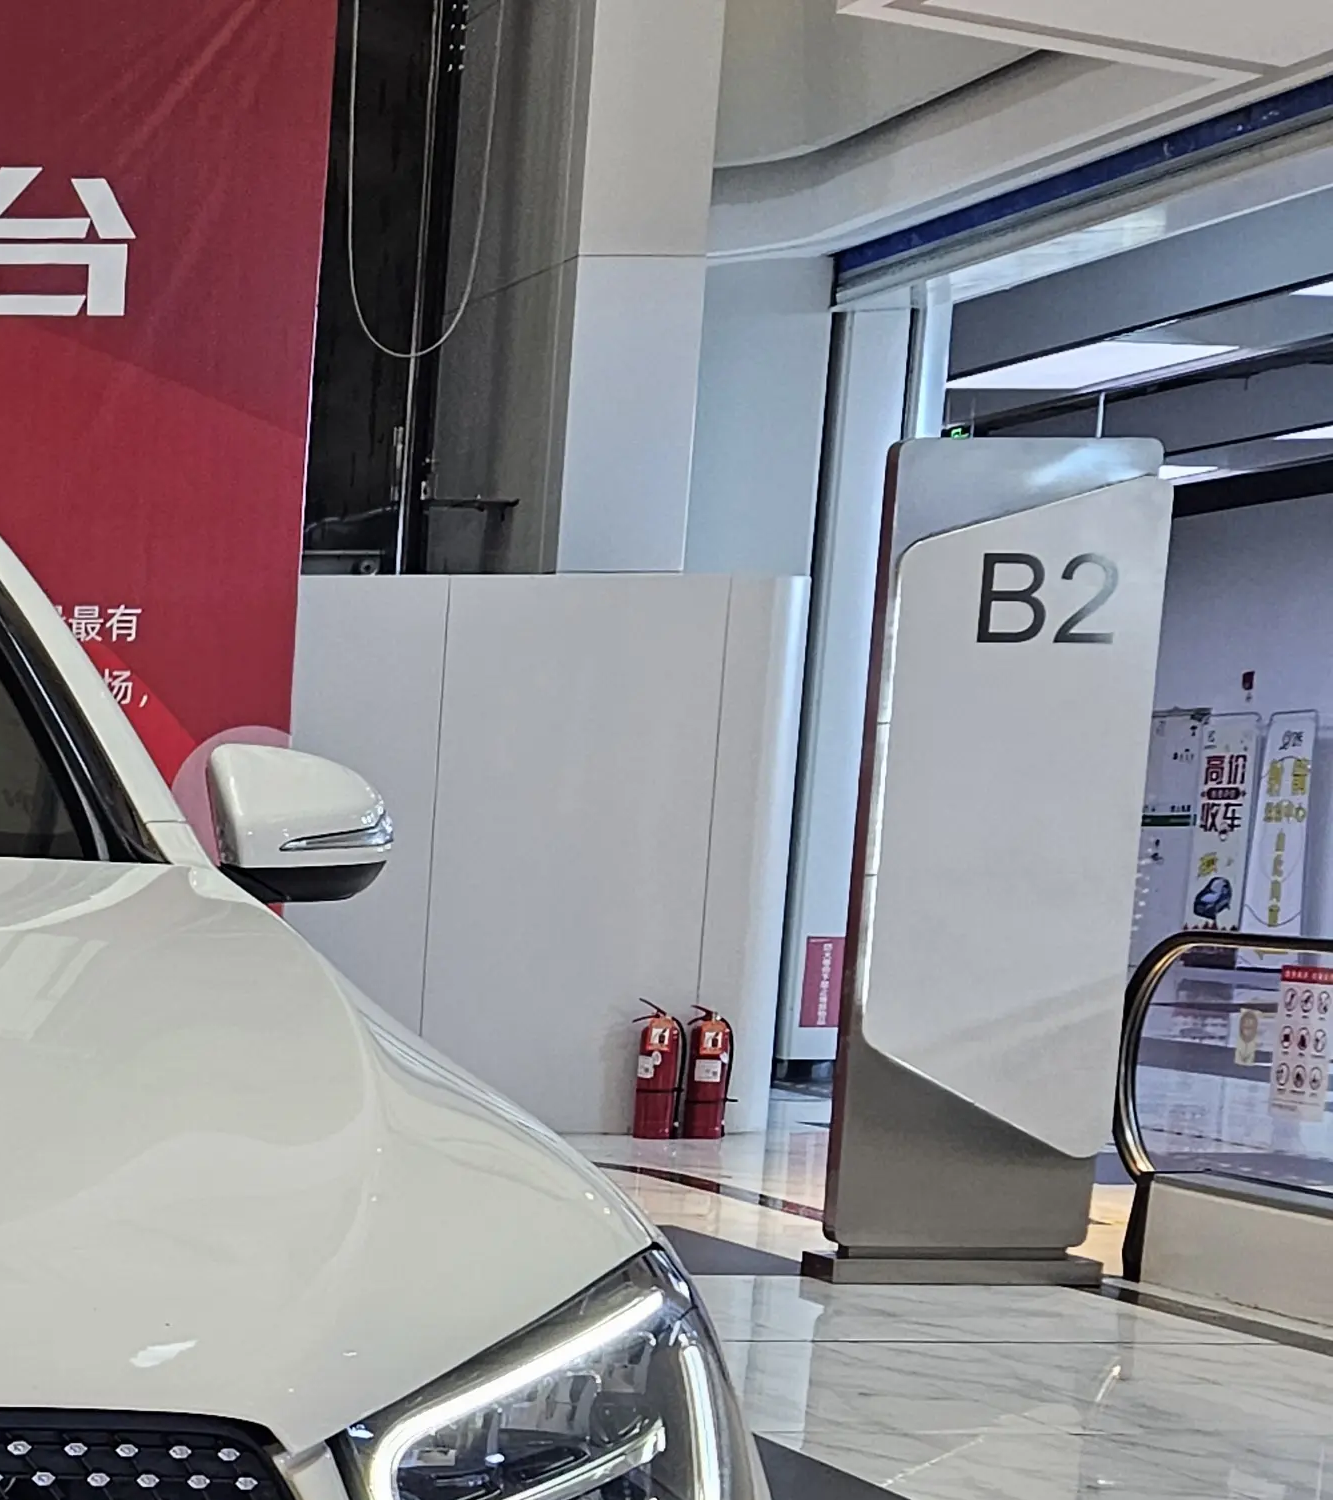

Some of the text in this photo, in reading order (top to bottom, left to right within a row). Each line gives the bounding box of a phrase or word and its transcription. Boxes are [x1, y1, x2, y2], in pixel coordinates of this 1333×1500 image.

[976, 551, 1119, 645] B2
[53, 603, 143, 643] 最有
[1203, 754, 1248, 786] 高价
[1199, 802, 1244, 833] 收车
